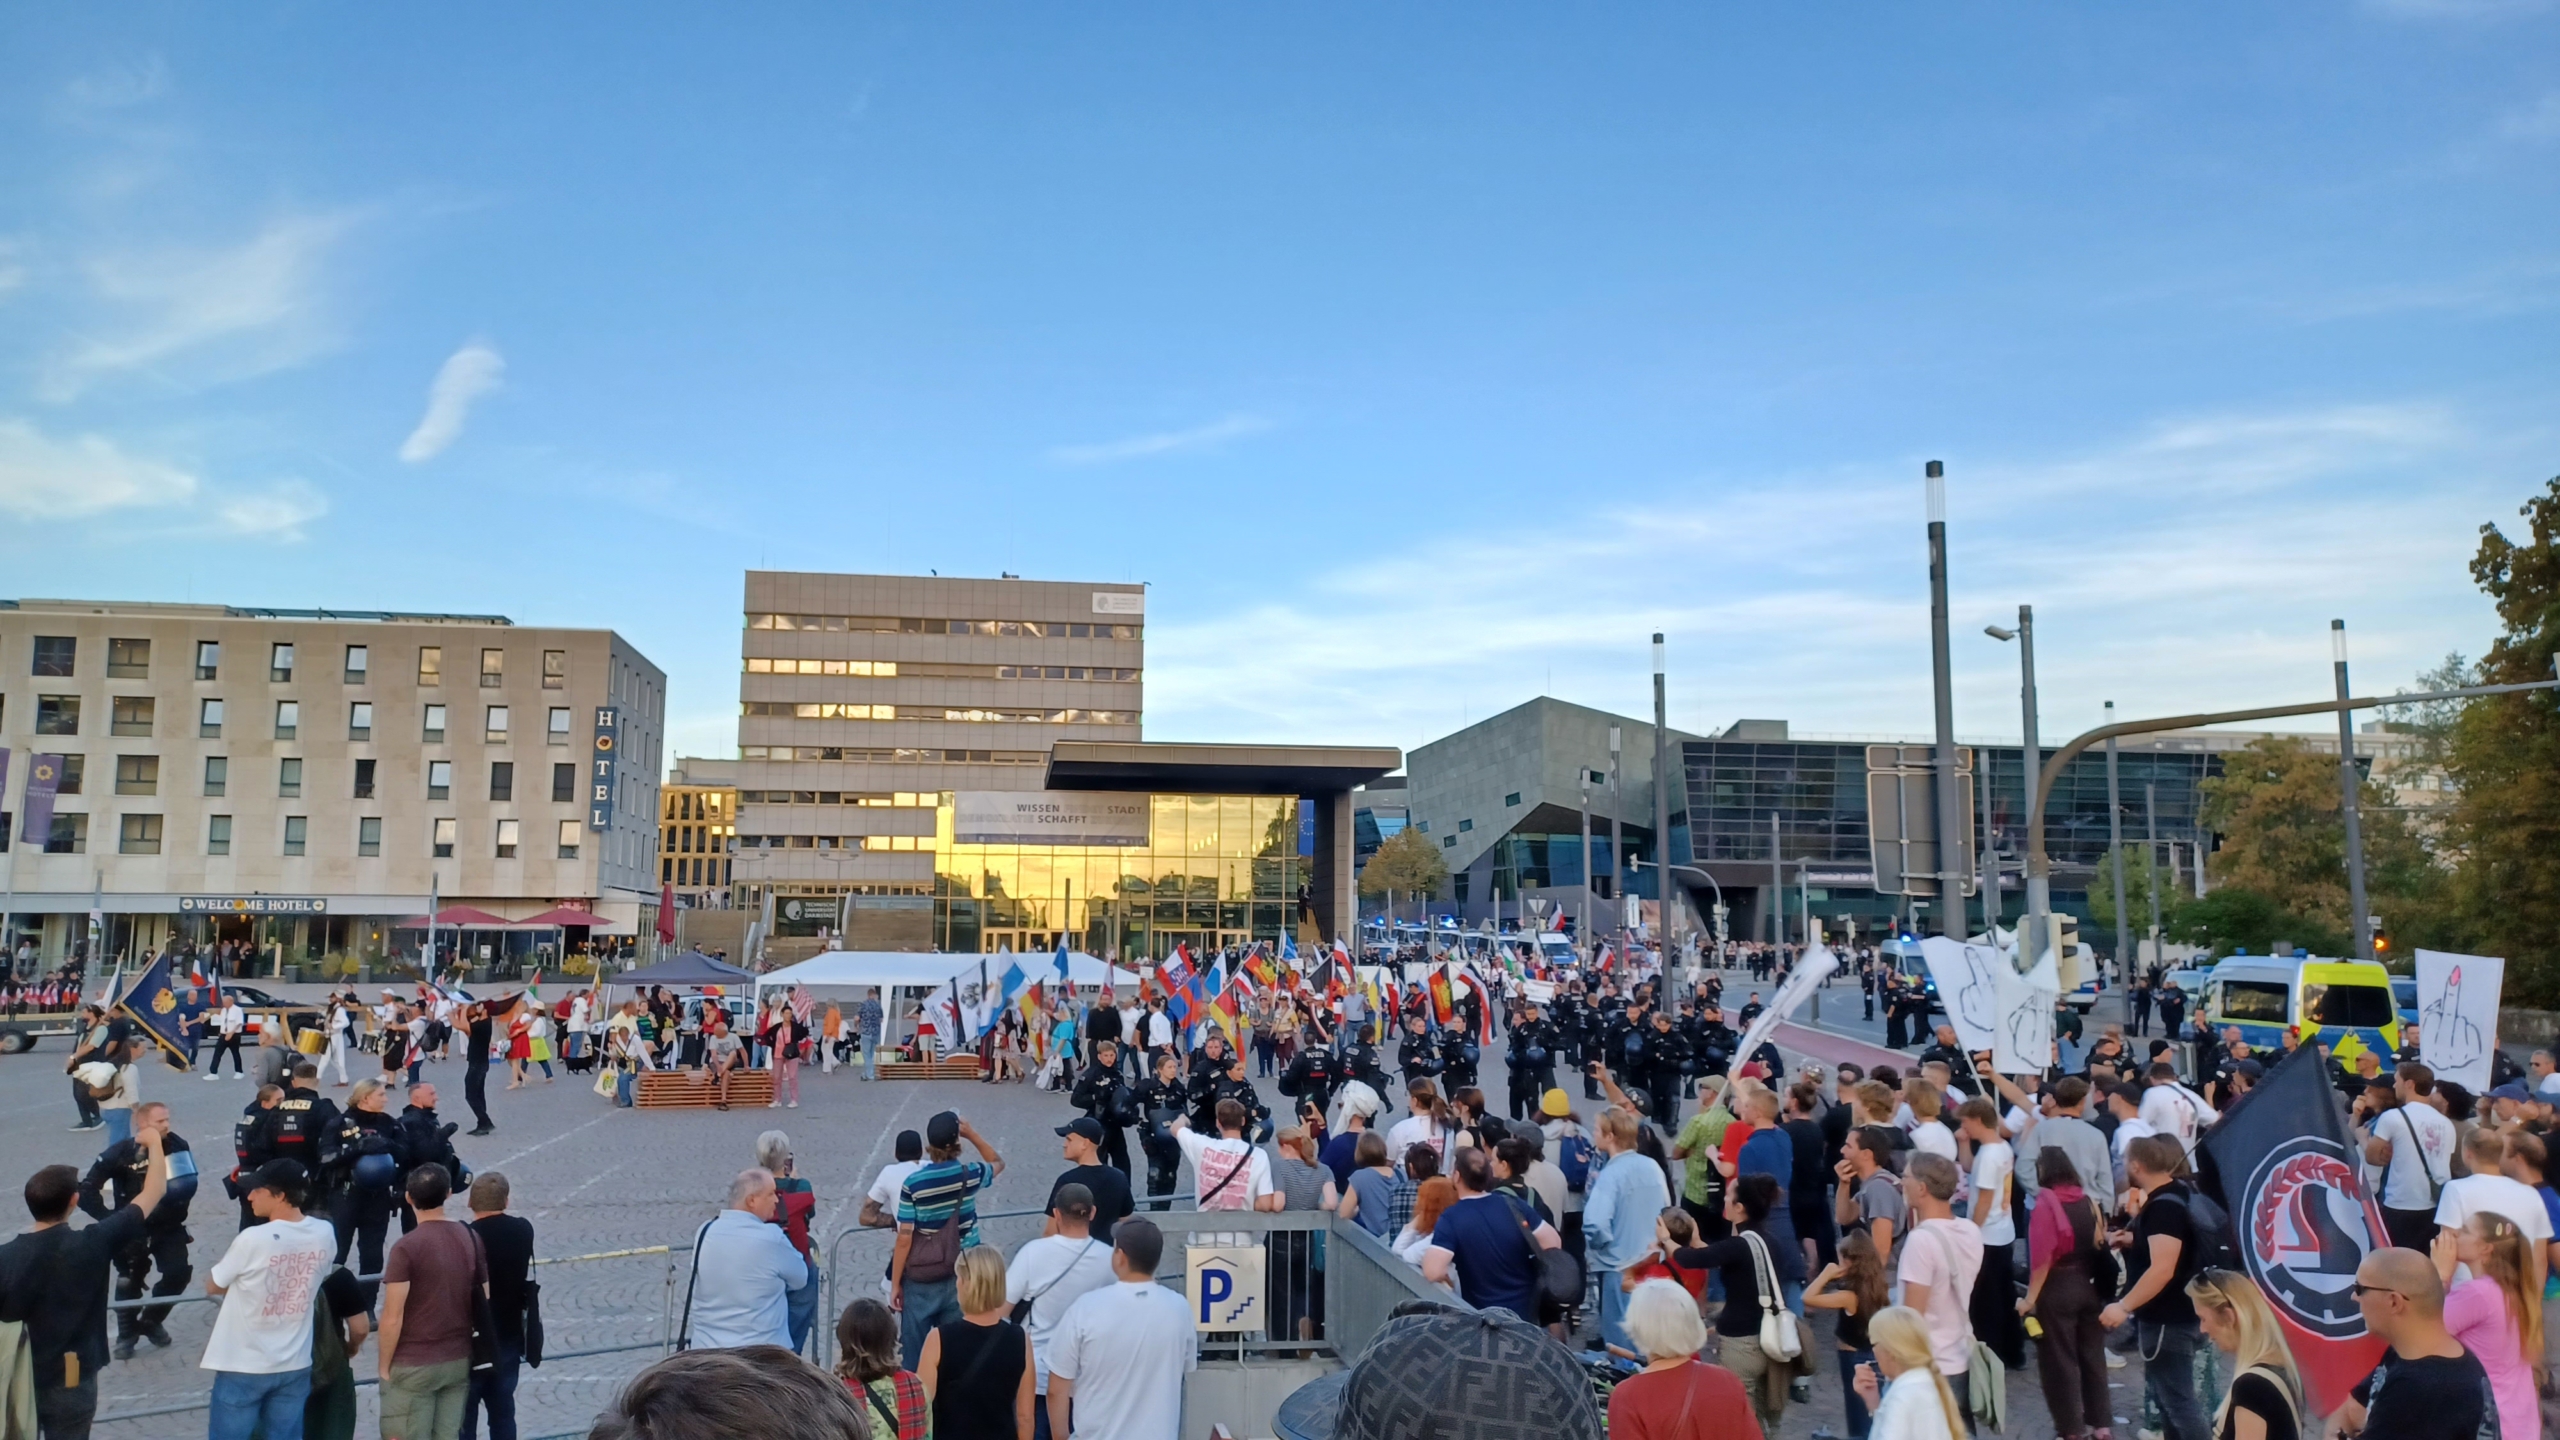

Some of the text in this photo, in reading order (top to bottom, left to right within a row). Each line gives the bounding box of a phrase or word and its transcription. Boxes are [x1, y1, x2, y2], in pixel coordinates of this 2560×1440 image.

[593, 711, 613, 826] HOTEL
[1017, 803, 1060, 813] WISSEN
[1107, 805, 1145, 815] STADT.
[1037, 815, 1087, 824] SCHAFFT
[196, 899, 312, 911] WELCOME HOTEL
[279, 1099, 312, 1111] POLIZEI
[269, 1249, 327, 1267] SPREAD
[277, 1263, 316, 1278] LOVE
[278, 1277, 309, 1291] FOR
[1200, 1268, 1233, 1324] P
[262, 1301, 310, 1316] MUSIC
